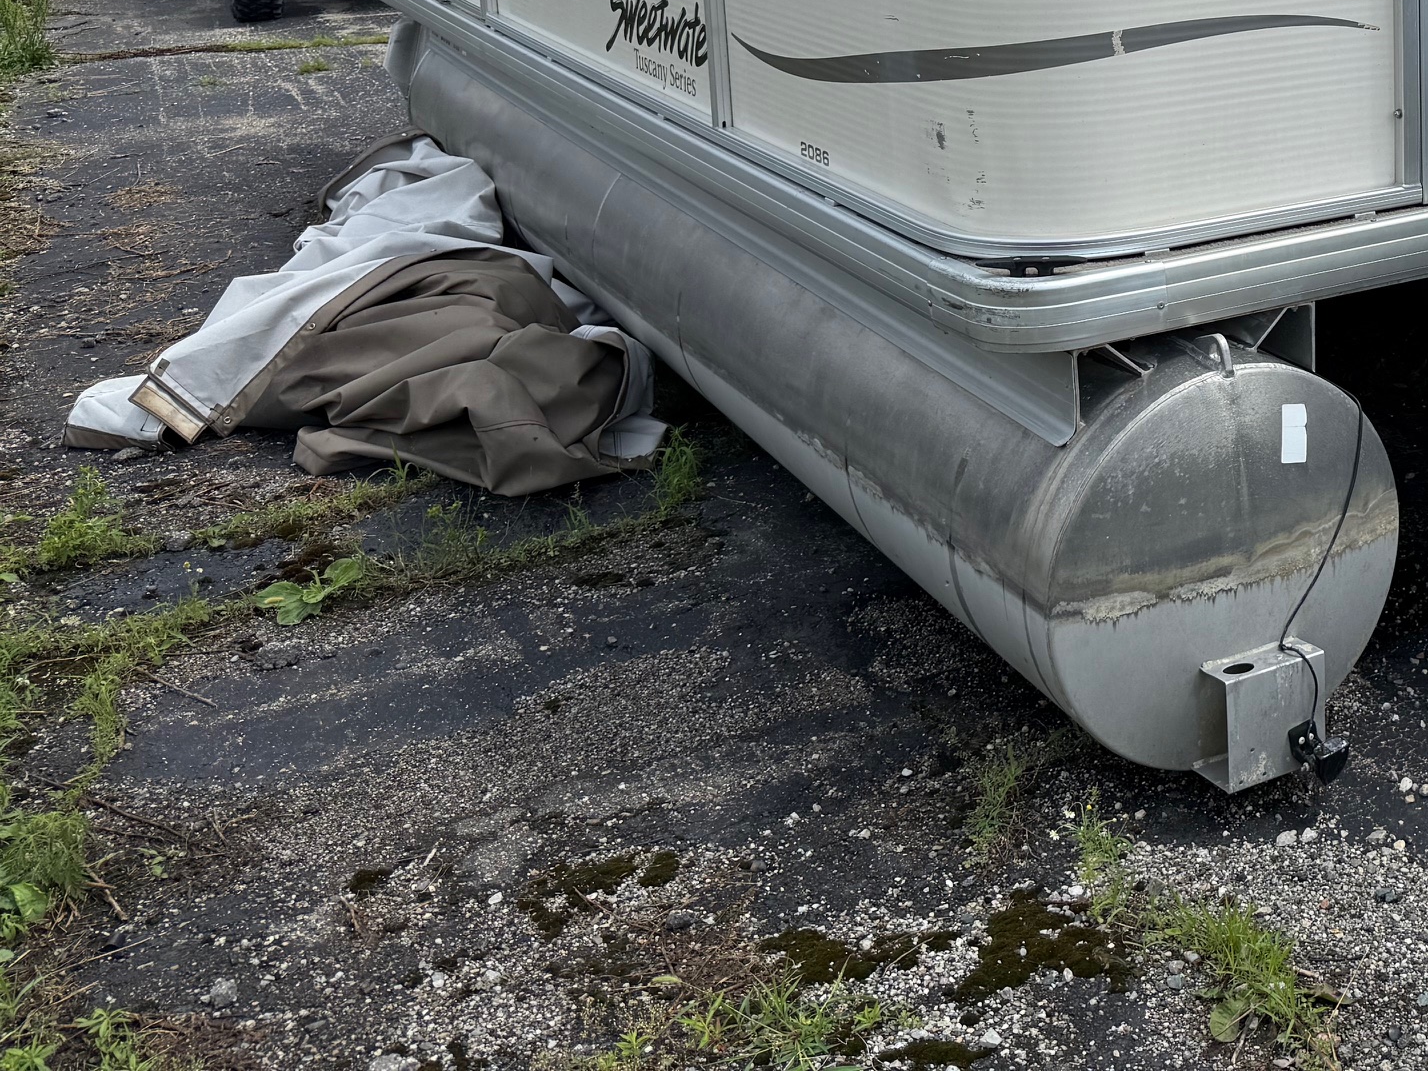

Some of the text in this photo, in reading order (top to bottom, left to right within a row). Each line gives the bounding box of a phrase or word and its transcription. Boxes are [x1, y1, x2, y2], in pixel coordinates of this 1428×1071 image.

[633, 47, 697, 97] Tuscany Series
[800, 140, 830, 167] 2086
